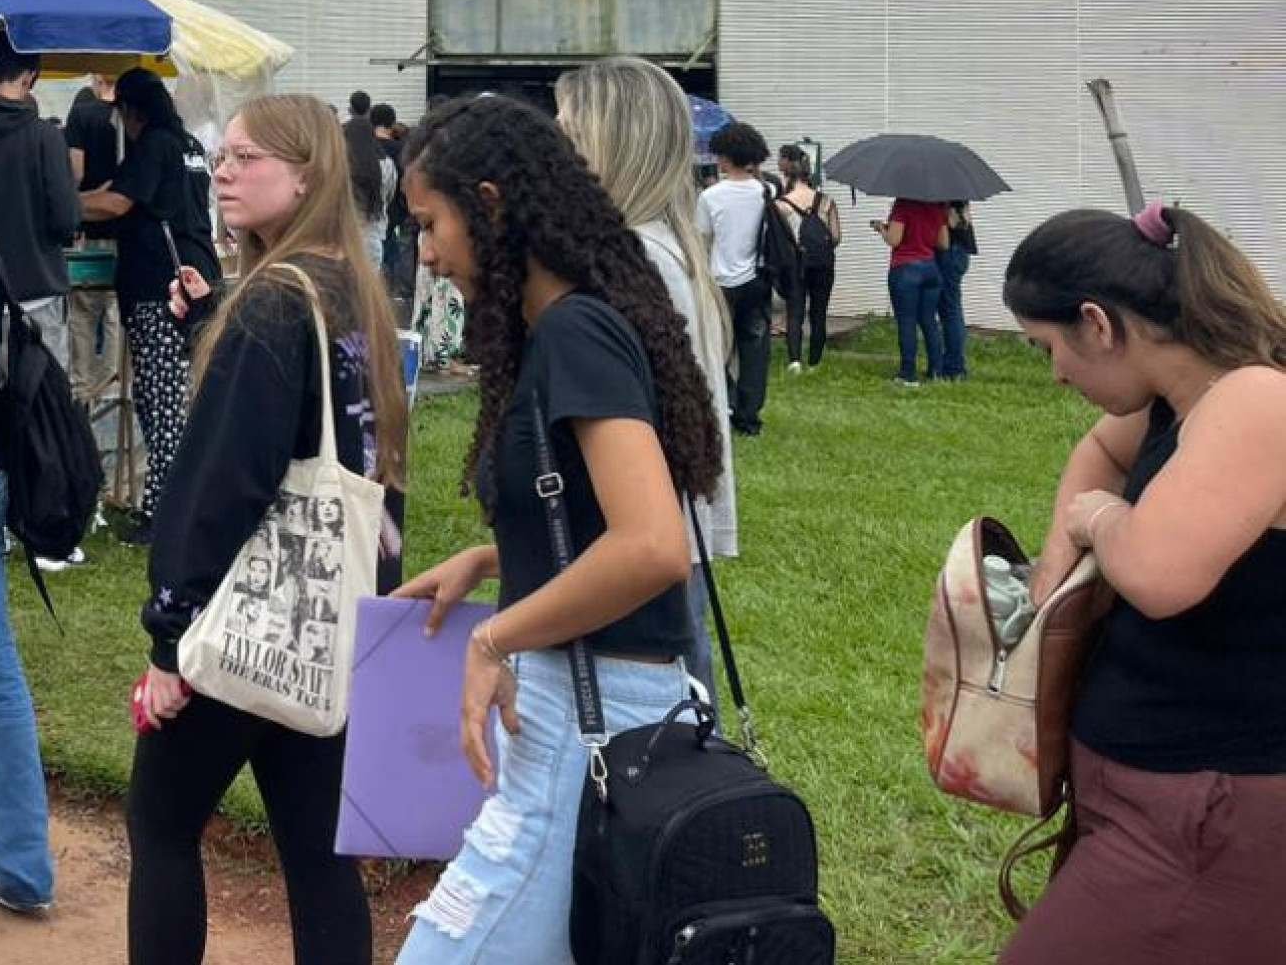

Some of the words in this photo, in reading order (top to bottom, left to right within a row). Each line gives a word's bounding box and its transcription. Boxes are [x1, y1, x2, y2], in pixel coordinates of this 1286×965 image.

[218, 655, 249, 679] THE
[252, 669, 291, 696] ERAS
[222, 630, 287, 678] TAYLOR
